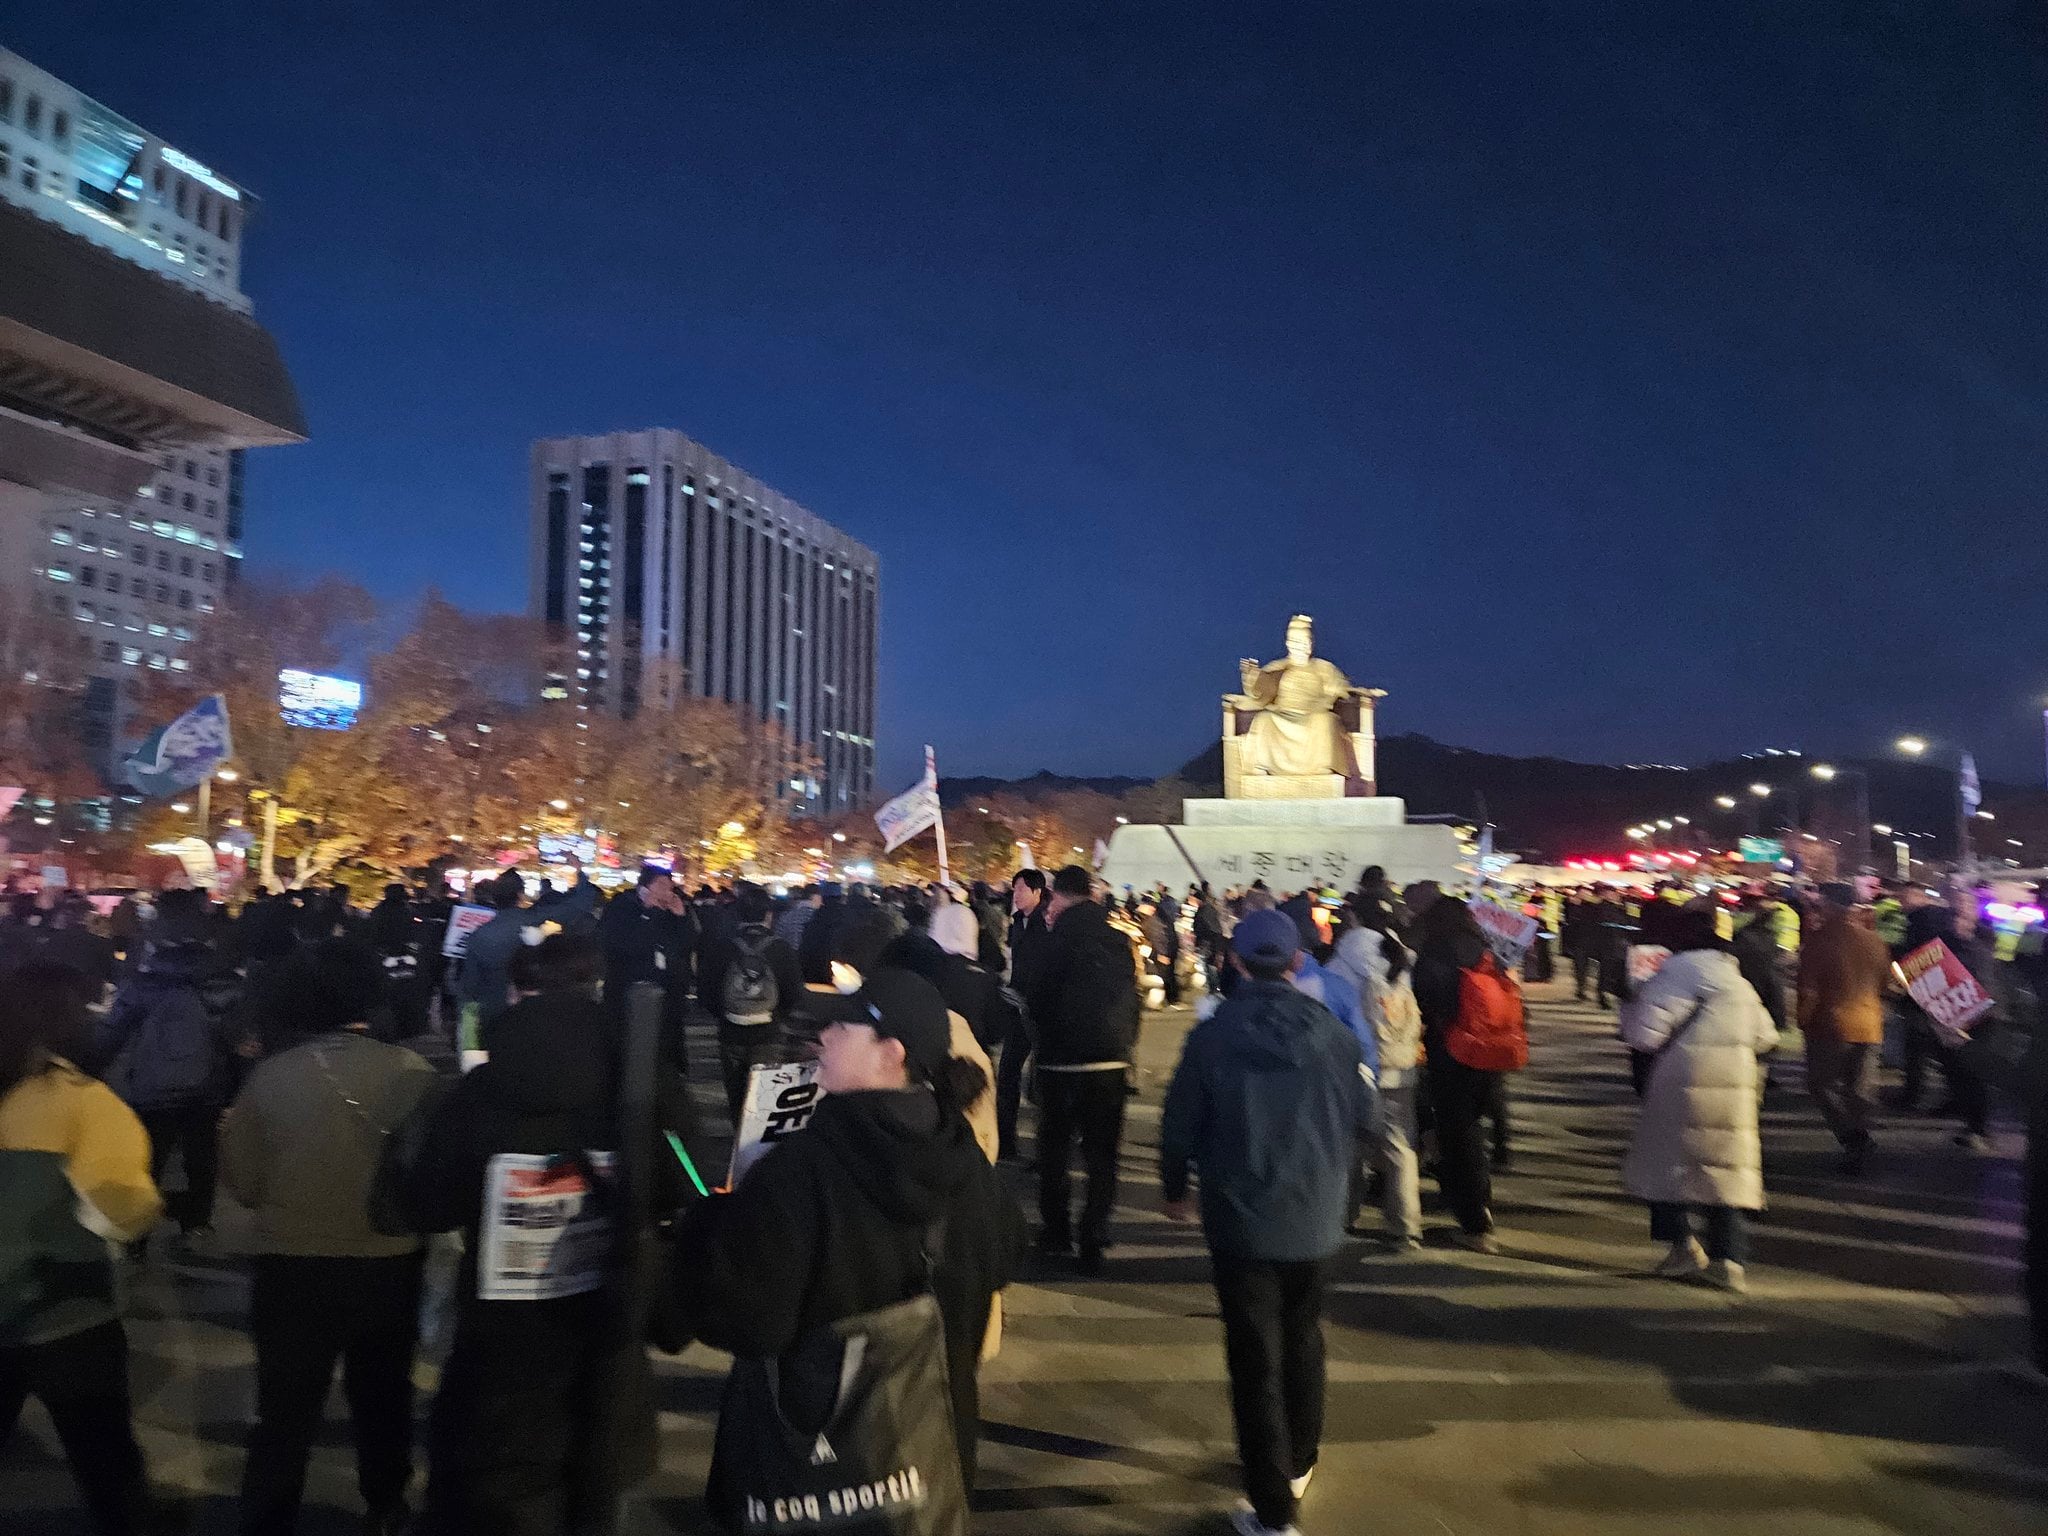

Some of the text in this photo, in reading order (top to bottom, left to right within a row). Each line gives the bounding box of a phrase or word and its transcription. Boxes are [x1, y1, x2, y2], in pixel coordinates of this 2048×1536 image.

[1218, 851, 1348, 878] 세종대왕
[747, 1464, 921, 1524] le coq sportif
